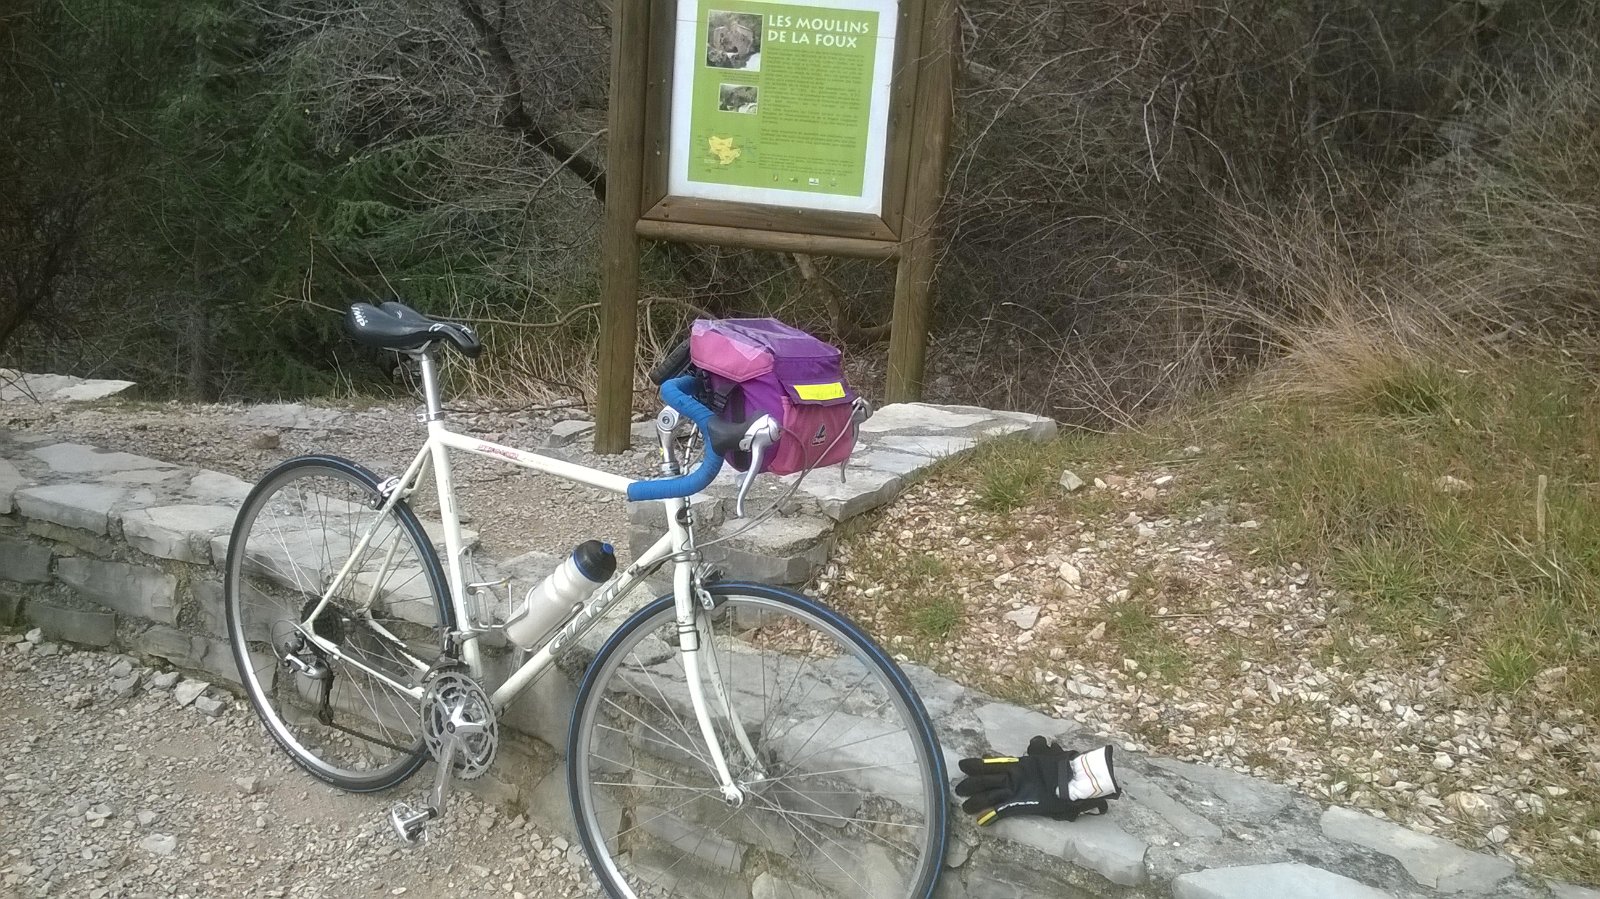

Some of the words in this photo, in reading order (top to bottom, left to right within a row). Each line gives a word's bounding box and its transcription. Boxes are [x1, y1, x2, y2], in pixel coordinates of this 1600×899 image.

[769, 14, 791, 27] LES
[796, 17, 869, 33] MOULINS
[768, 29, 786, 42] DE
[791, 32, 810, 44] LA
[815, 34, 857, 48] FOUX
[549, 576, 622, 655] GIANT
